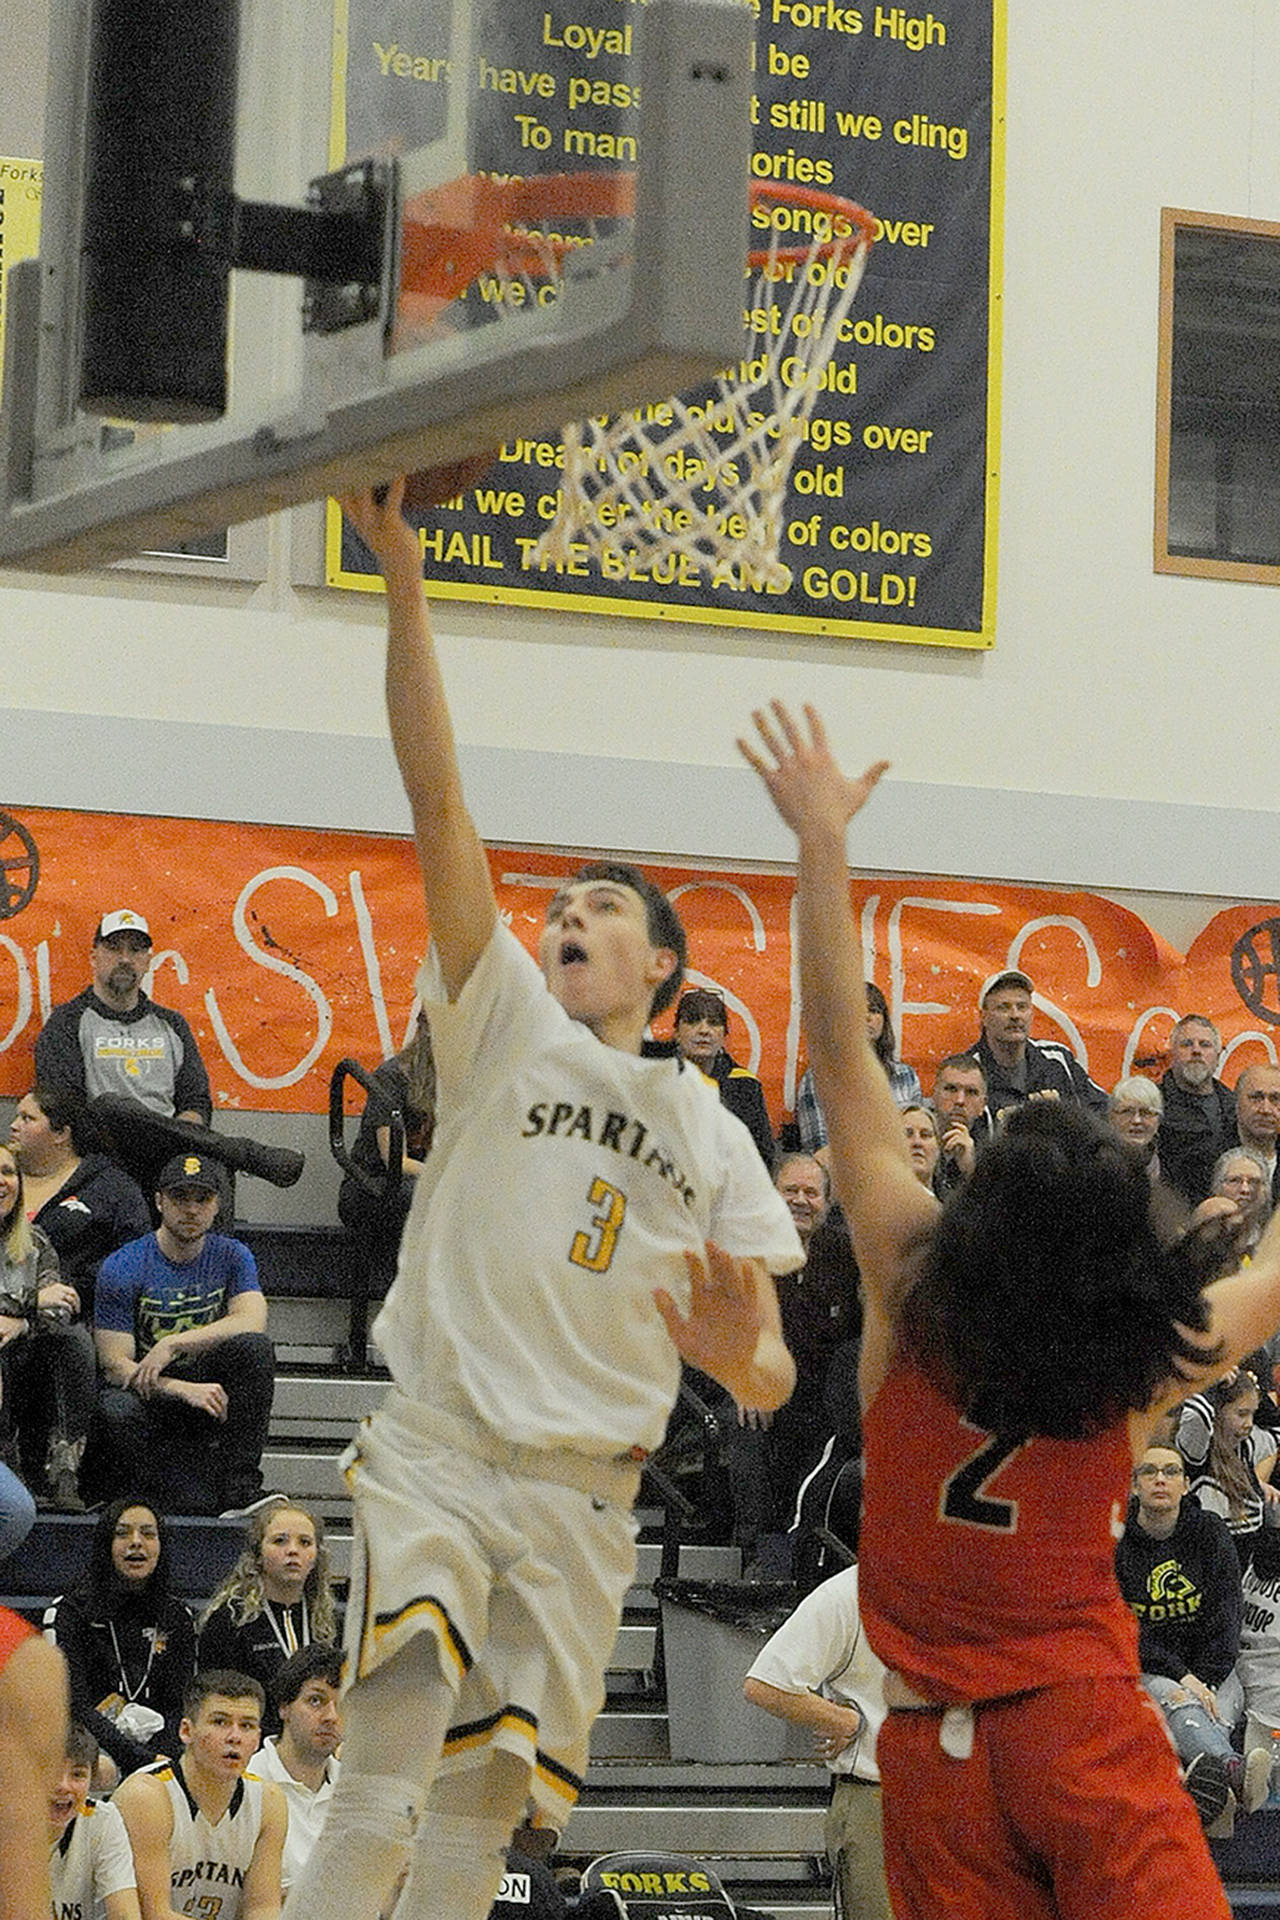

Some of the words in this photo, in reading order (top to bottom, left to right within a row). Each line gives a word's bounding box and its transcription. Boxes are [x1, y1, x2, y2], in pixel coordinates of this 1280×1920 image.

[543, 12, 633, 59] Loyal
[769, 43, 810, 79] be
[771, 0, 863, 35] Forks
[874, 5, 946, 51] High
[478, 56, 556, 98] have
[769, 100, 827, 133] still
[835, 111, 883, 141] we
[893, 114, 968, 160] cling
[514, 113, 552, 150] To
[564, 128, 637, 162] man
[751, 148, 835, 185] ories
[752, 203, 853, 244] songs
[866, 216, 934, 248] over
[478, 277, 526, 307] we
[837, 313, 936, 352] colors
[863, 423, 933, 453] over
[664, 449, 740, 492] days
[794, 464, 844, 498] old
[475, 489, 525, 518] we
[788, 515, 822, 547] of
[829, 520, 933, 558] colors
[419, 527, 504, 569] HAIL
[515, 537, 590, 577] THE
[601, 545, 702, 587] BLUE
[802, 565, 917, 608] GOLD!
[95, 1036, 166, 1049] FORKS
[568, 1175, 628, 1274] 3
[600, 1872, 711, 1895] FORKS
